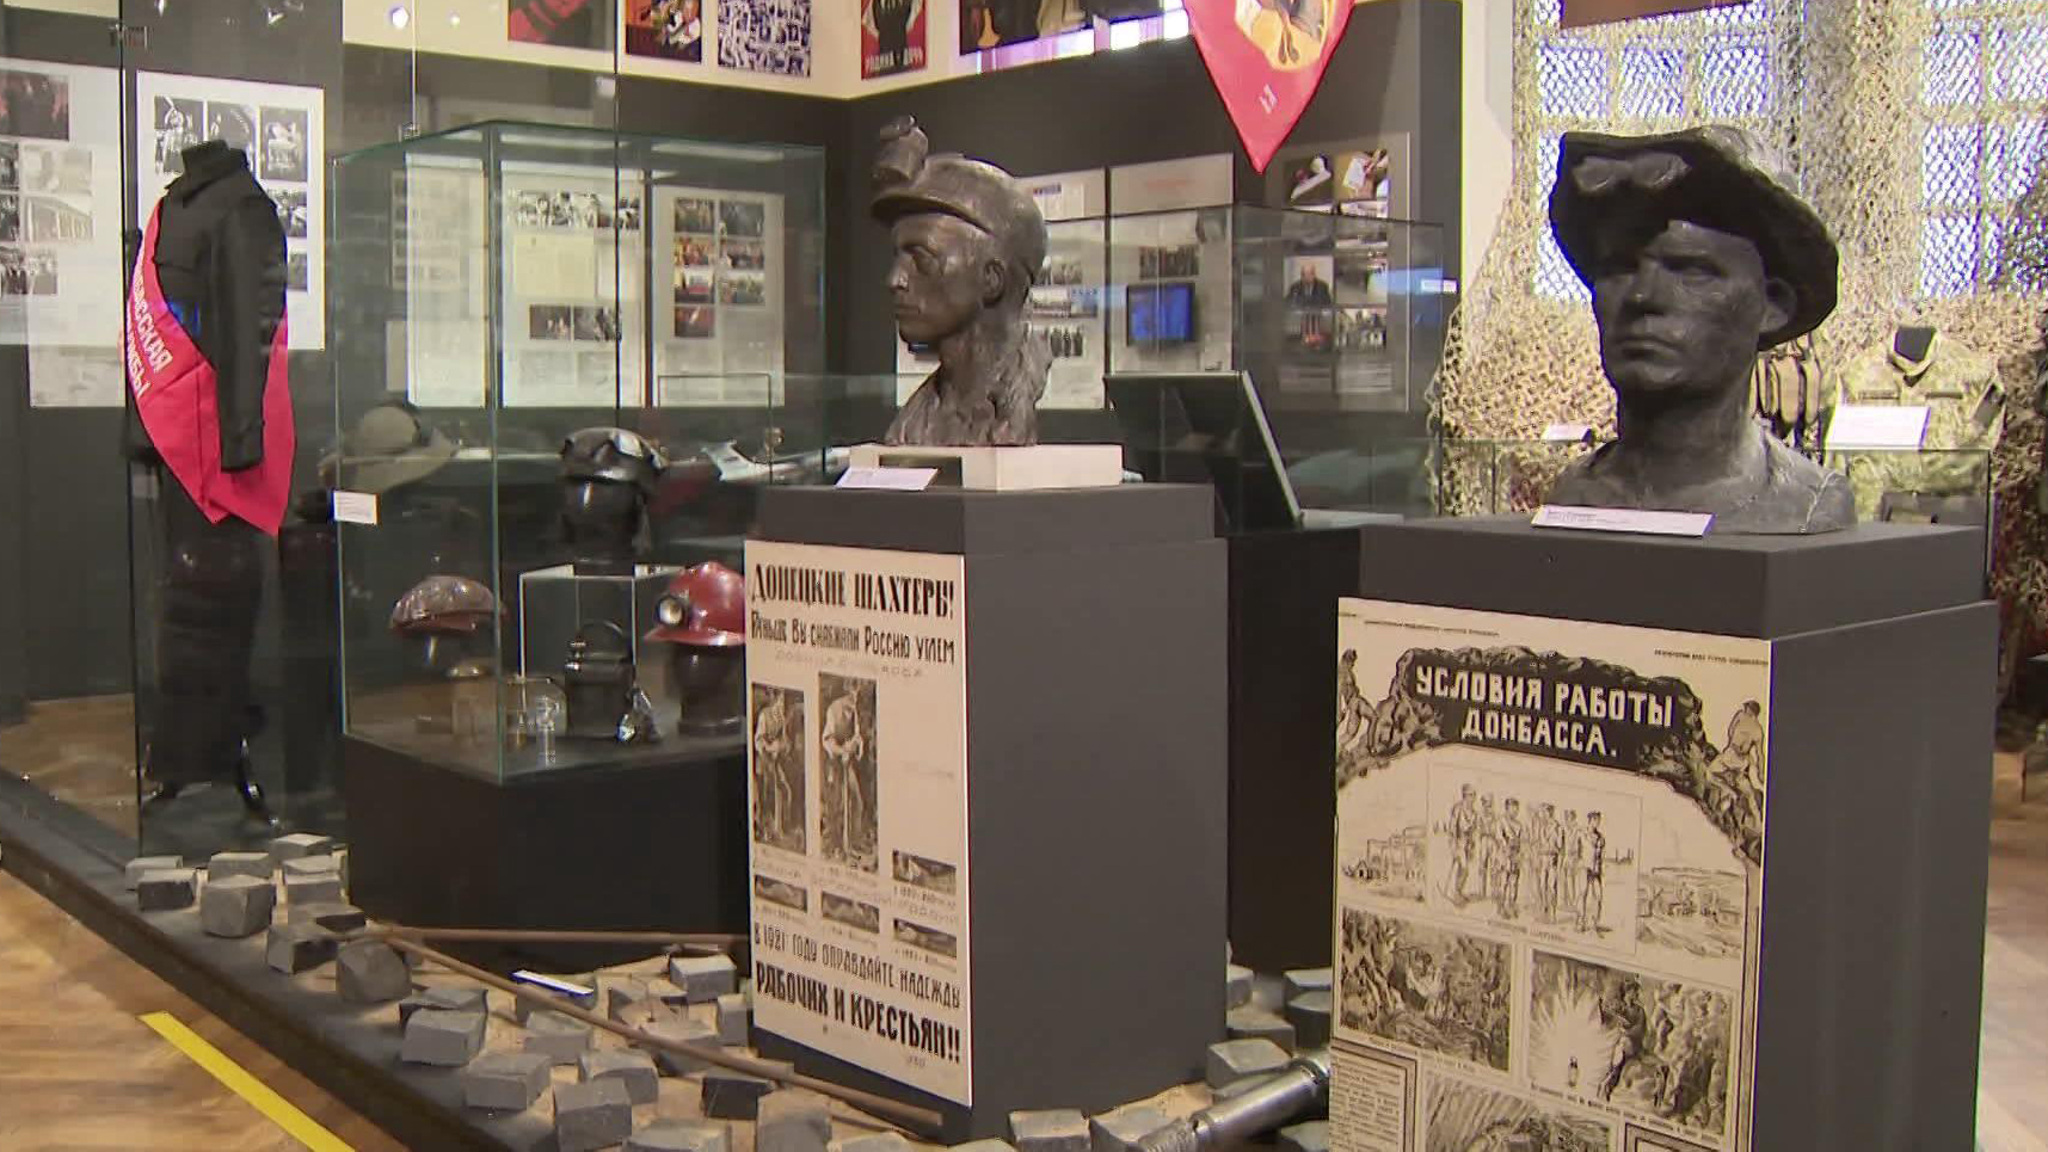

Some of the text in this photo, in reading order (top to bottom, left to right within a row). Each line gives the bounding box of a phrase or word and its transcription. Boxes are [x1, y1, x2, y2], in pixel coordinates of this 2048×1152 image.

[751, 563, 955, 620] ДОНЕЦКИЕ ШАХТЕРЫ!
[1416, 666, 1674, 728] УСЛОВИЯ РАБОТЫ
[1461, 709, 1618, 758] ДОНБАССА.
[793, 934, 817, 963] ГОДУ
[822, 943, 894, 988] ОПРАВДАЙТЕ
[900, 970, 961, 1009] НАДЕЖДЫ
[756, 961, 961, 1064] РАБОЧИХ И КРЕСТЬЯН!!
